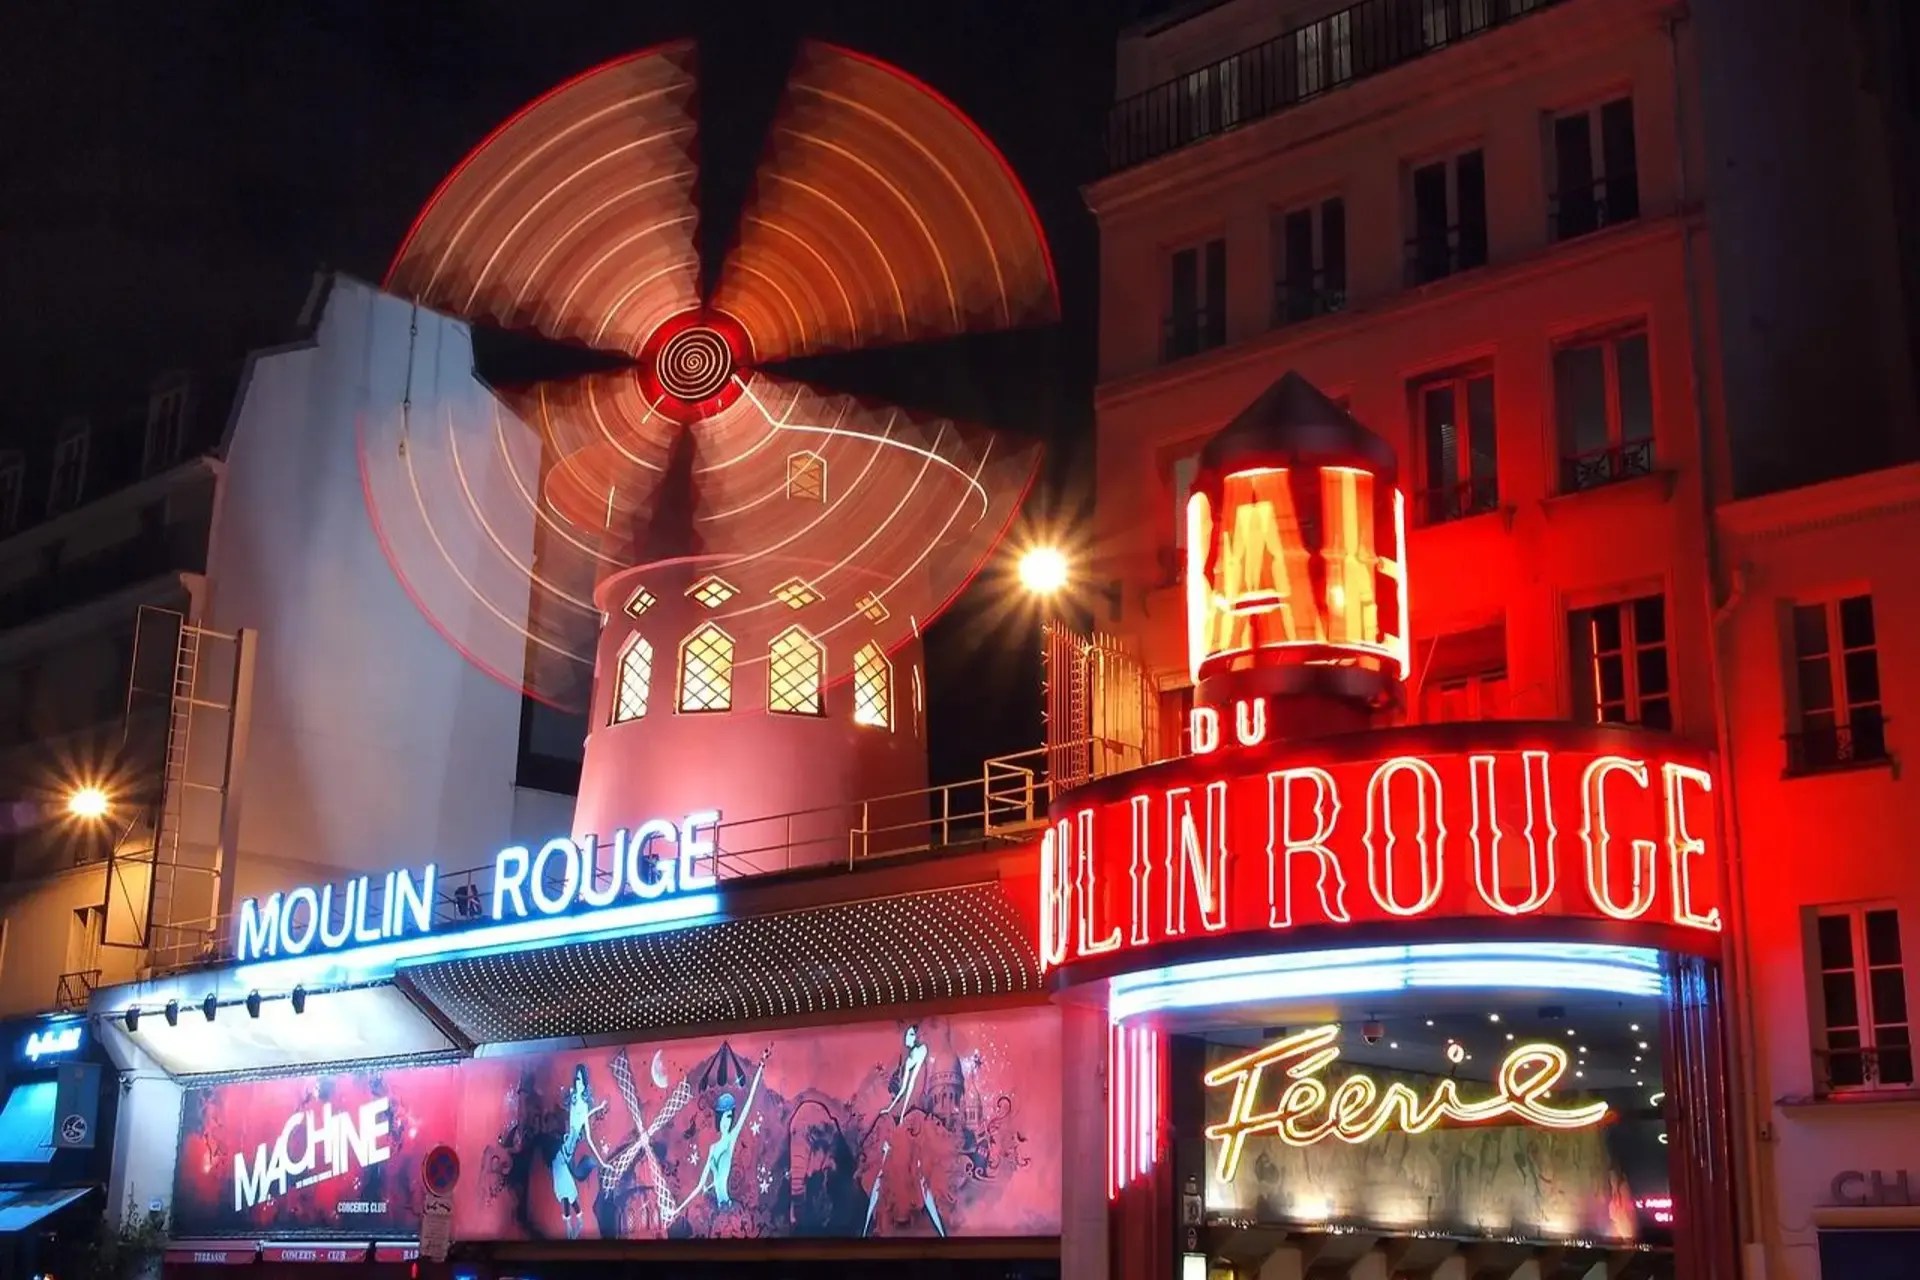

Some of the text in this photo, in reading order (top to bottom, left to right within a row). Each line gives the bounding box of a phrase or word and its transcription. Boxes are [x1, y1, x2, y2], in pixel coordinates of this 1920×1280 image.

[1190, 698, 1266, 754] DU
[236, 809, 722, 961] MOULIN ROUGE
[1266, 750, 1723, 932] ROUGE
[233, 1096, 391, 1213] MACHINE
[1204, 1022, 1610, 1184] Féerie
[281, 1249, 346, 1261] CONCERTS CLUB
[336, 1201, 387, 1214] CONCERTS CLUB
